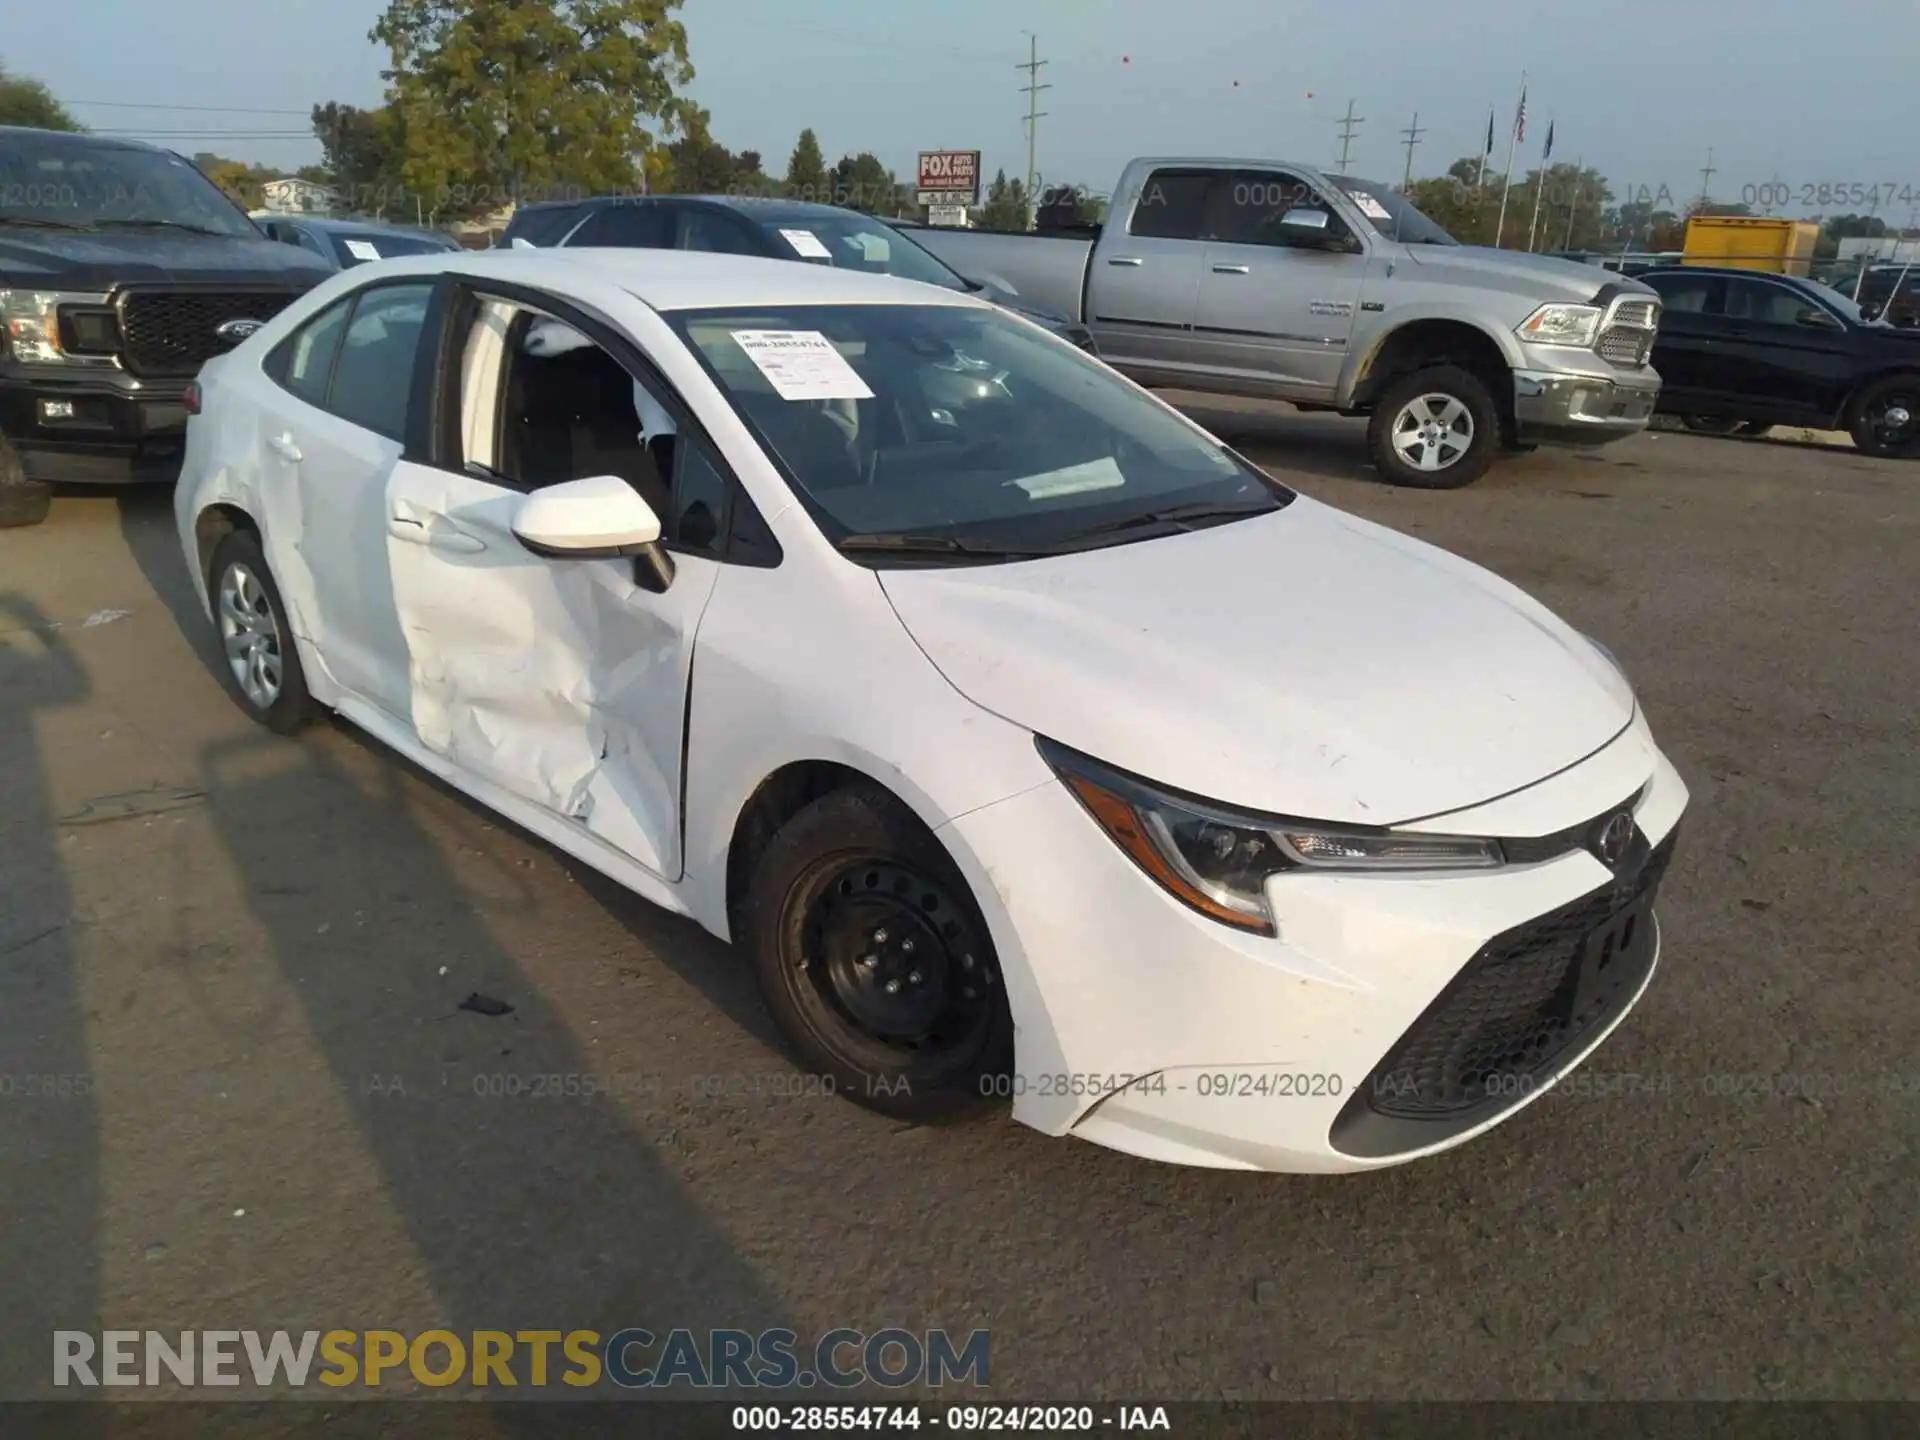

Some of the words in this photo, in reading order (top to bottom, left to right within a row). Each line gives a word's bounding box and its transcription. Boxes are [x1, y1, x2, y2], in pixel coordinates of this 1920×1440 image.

[953, 154, 973, 165] AUTO
[920, 155, 953, 176] FOX
[952, 165, 974, 176] PARTS
